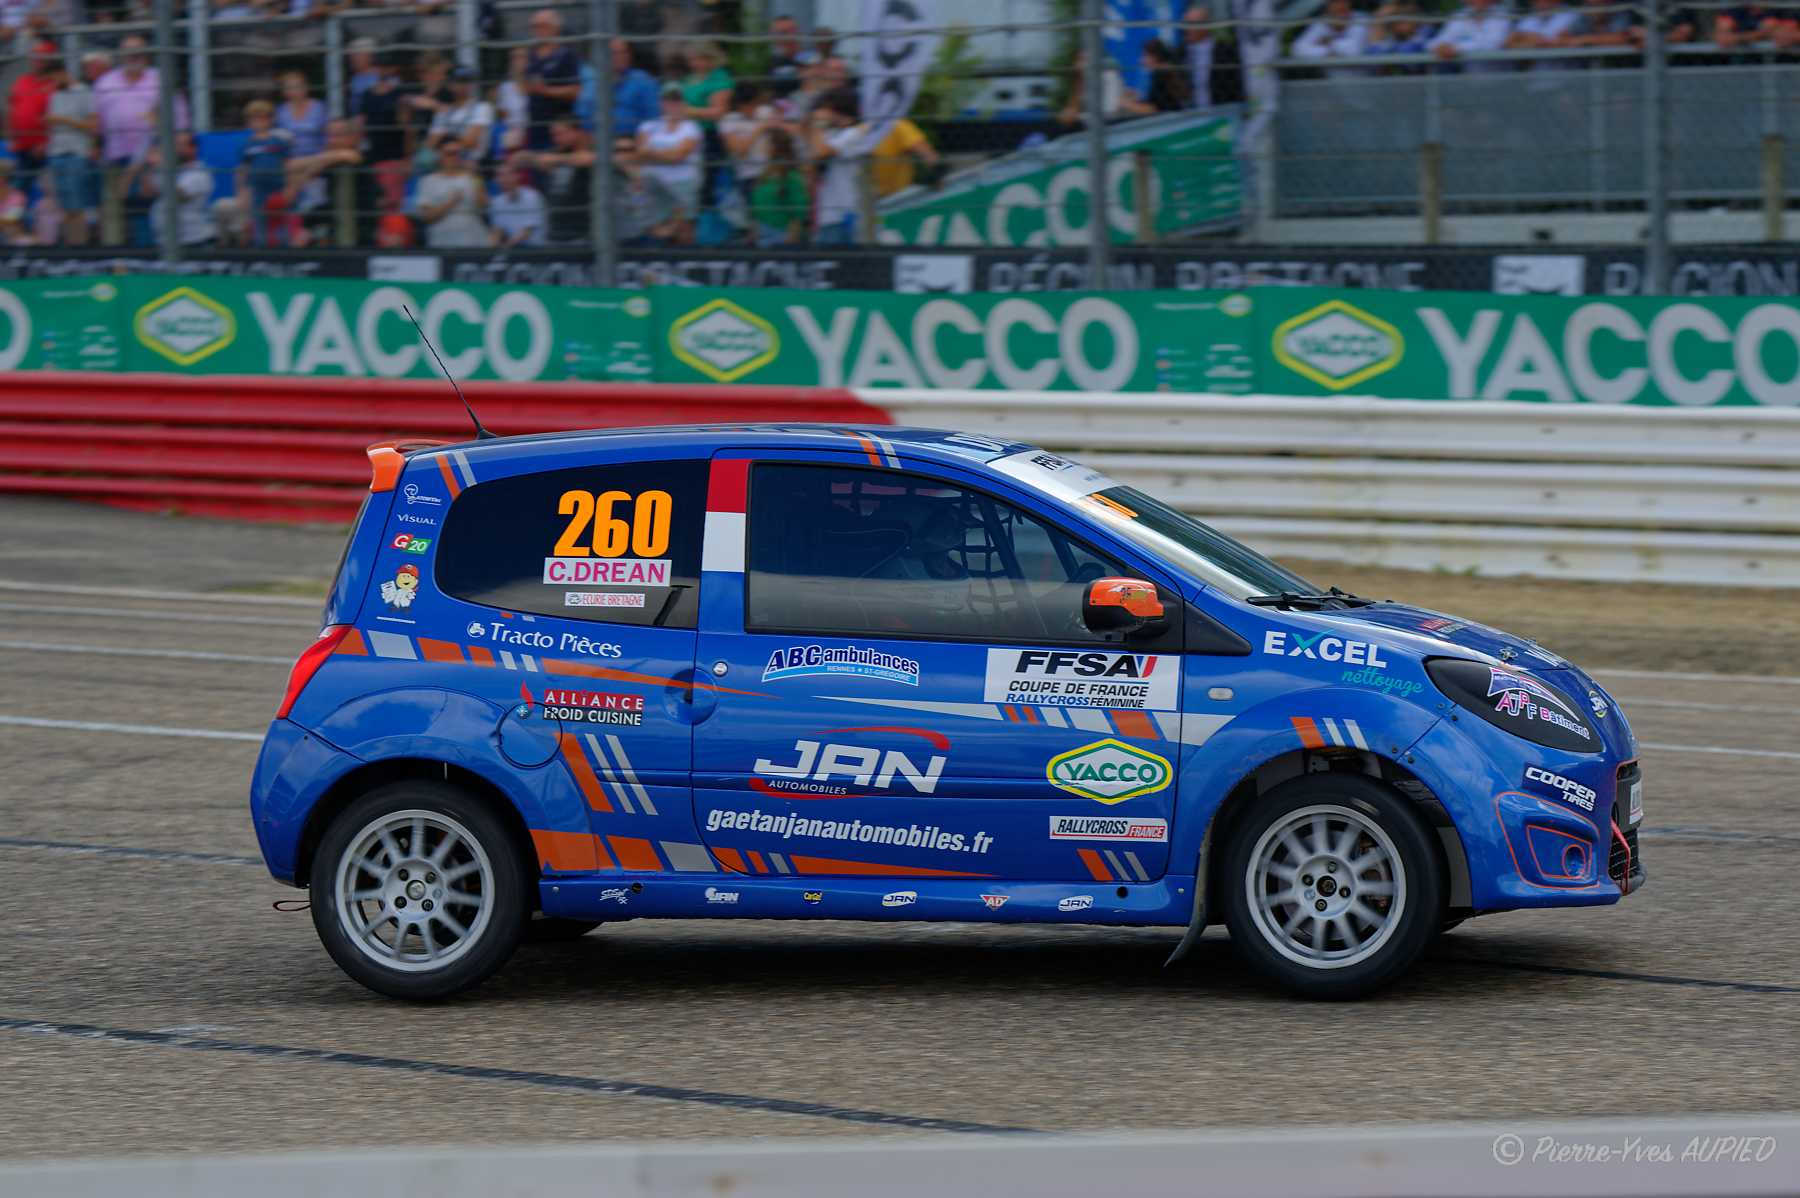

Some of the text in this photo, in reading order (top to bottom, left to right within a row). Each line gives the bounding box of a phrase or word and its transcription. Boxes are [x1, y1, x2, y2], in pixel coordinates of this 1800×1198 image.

[245, 286, 552, 383] YACCO
[785, 297, 1139, 393] YACCO
[1415, 302, 1800, 407] YACCO
[554, 490, 673, 557] 260
[549, 561, 665, 583] C.DREAN
[490, 622, 623, 659] Tracto Pièces
[1263, 629, 1388, 669] EXCEL
[765, 646, 920, 676] ABC ambulances
[1015, 650, 1139, 679] FFSA
[1008, 680, 1150, 698] COUPE DE FRANCE
[1342, 667, 1425, 697] nettoyage
[1006, 693, 1090, 706] RALLYCROSS
[544, 707, 642, 726] FROID CUISINE
[753, 739, 947, 794] JAN
[1063, 762, 1157, 784] YACCO
[767, 779, 848, 796] AUTOMOBILES
[1525, 766, 1597, 803] COOPER
[1562, 790, 1594, 812] TIRES
[706, 807, 994, 855] gaetanjanautomobiles.fr
[1057, 819, 1165, 838] RALLYCROSS FRANCE
[883, 895, 916, 904] JAN
[1060, 898, 1092, 909] JAN
